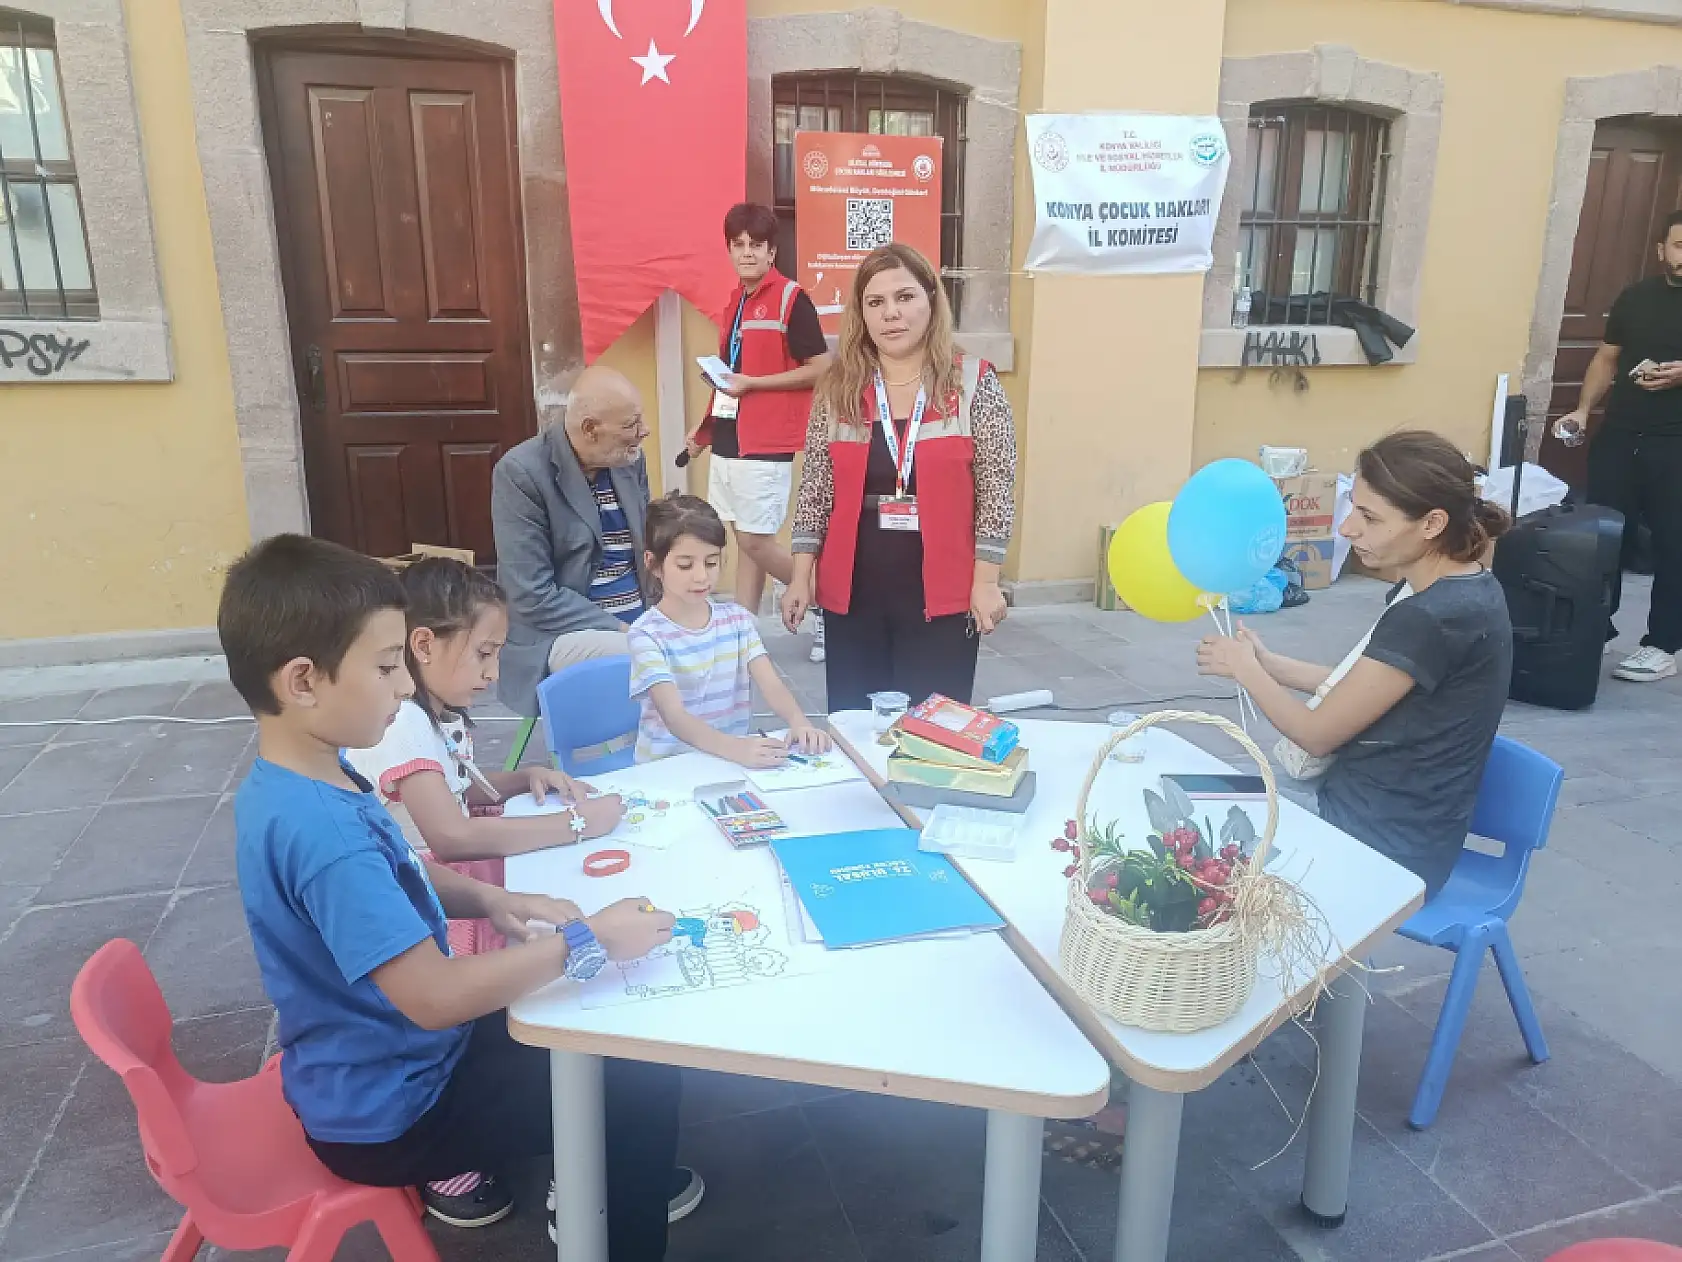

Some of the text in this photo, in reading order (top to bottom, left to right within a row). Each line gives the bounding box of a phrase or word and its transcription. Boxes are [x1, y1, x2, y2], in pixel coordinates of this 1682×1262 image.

[1046, 199, 1212, 223] KONYA ÇOCUK HAKLARI
[1088, 223, 1179, 247] İL KOMİTESİ
